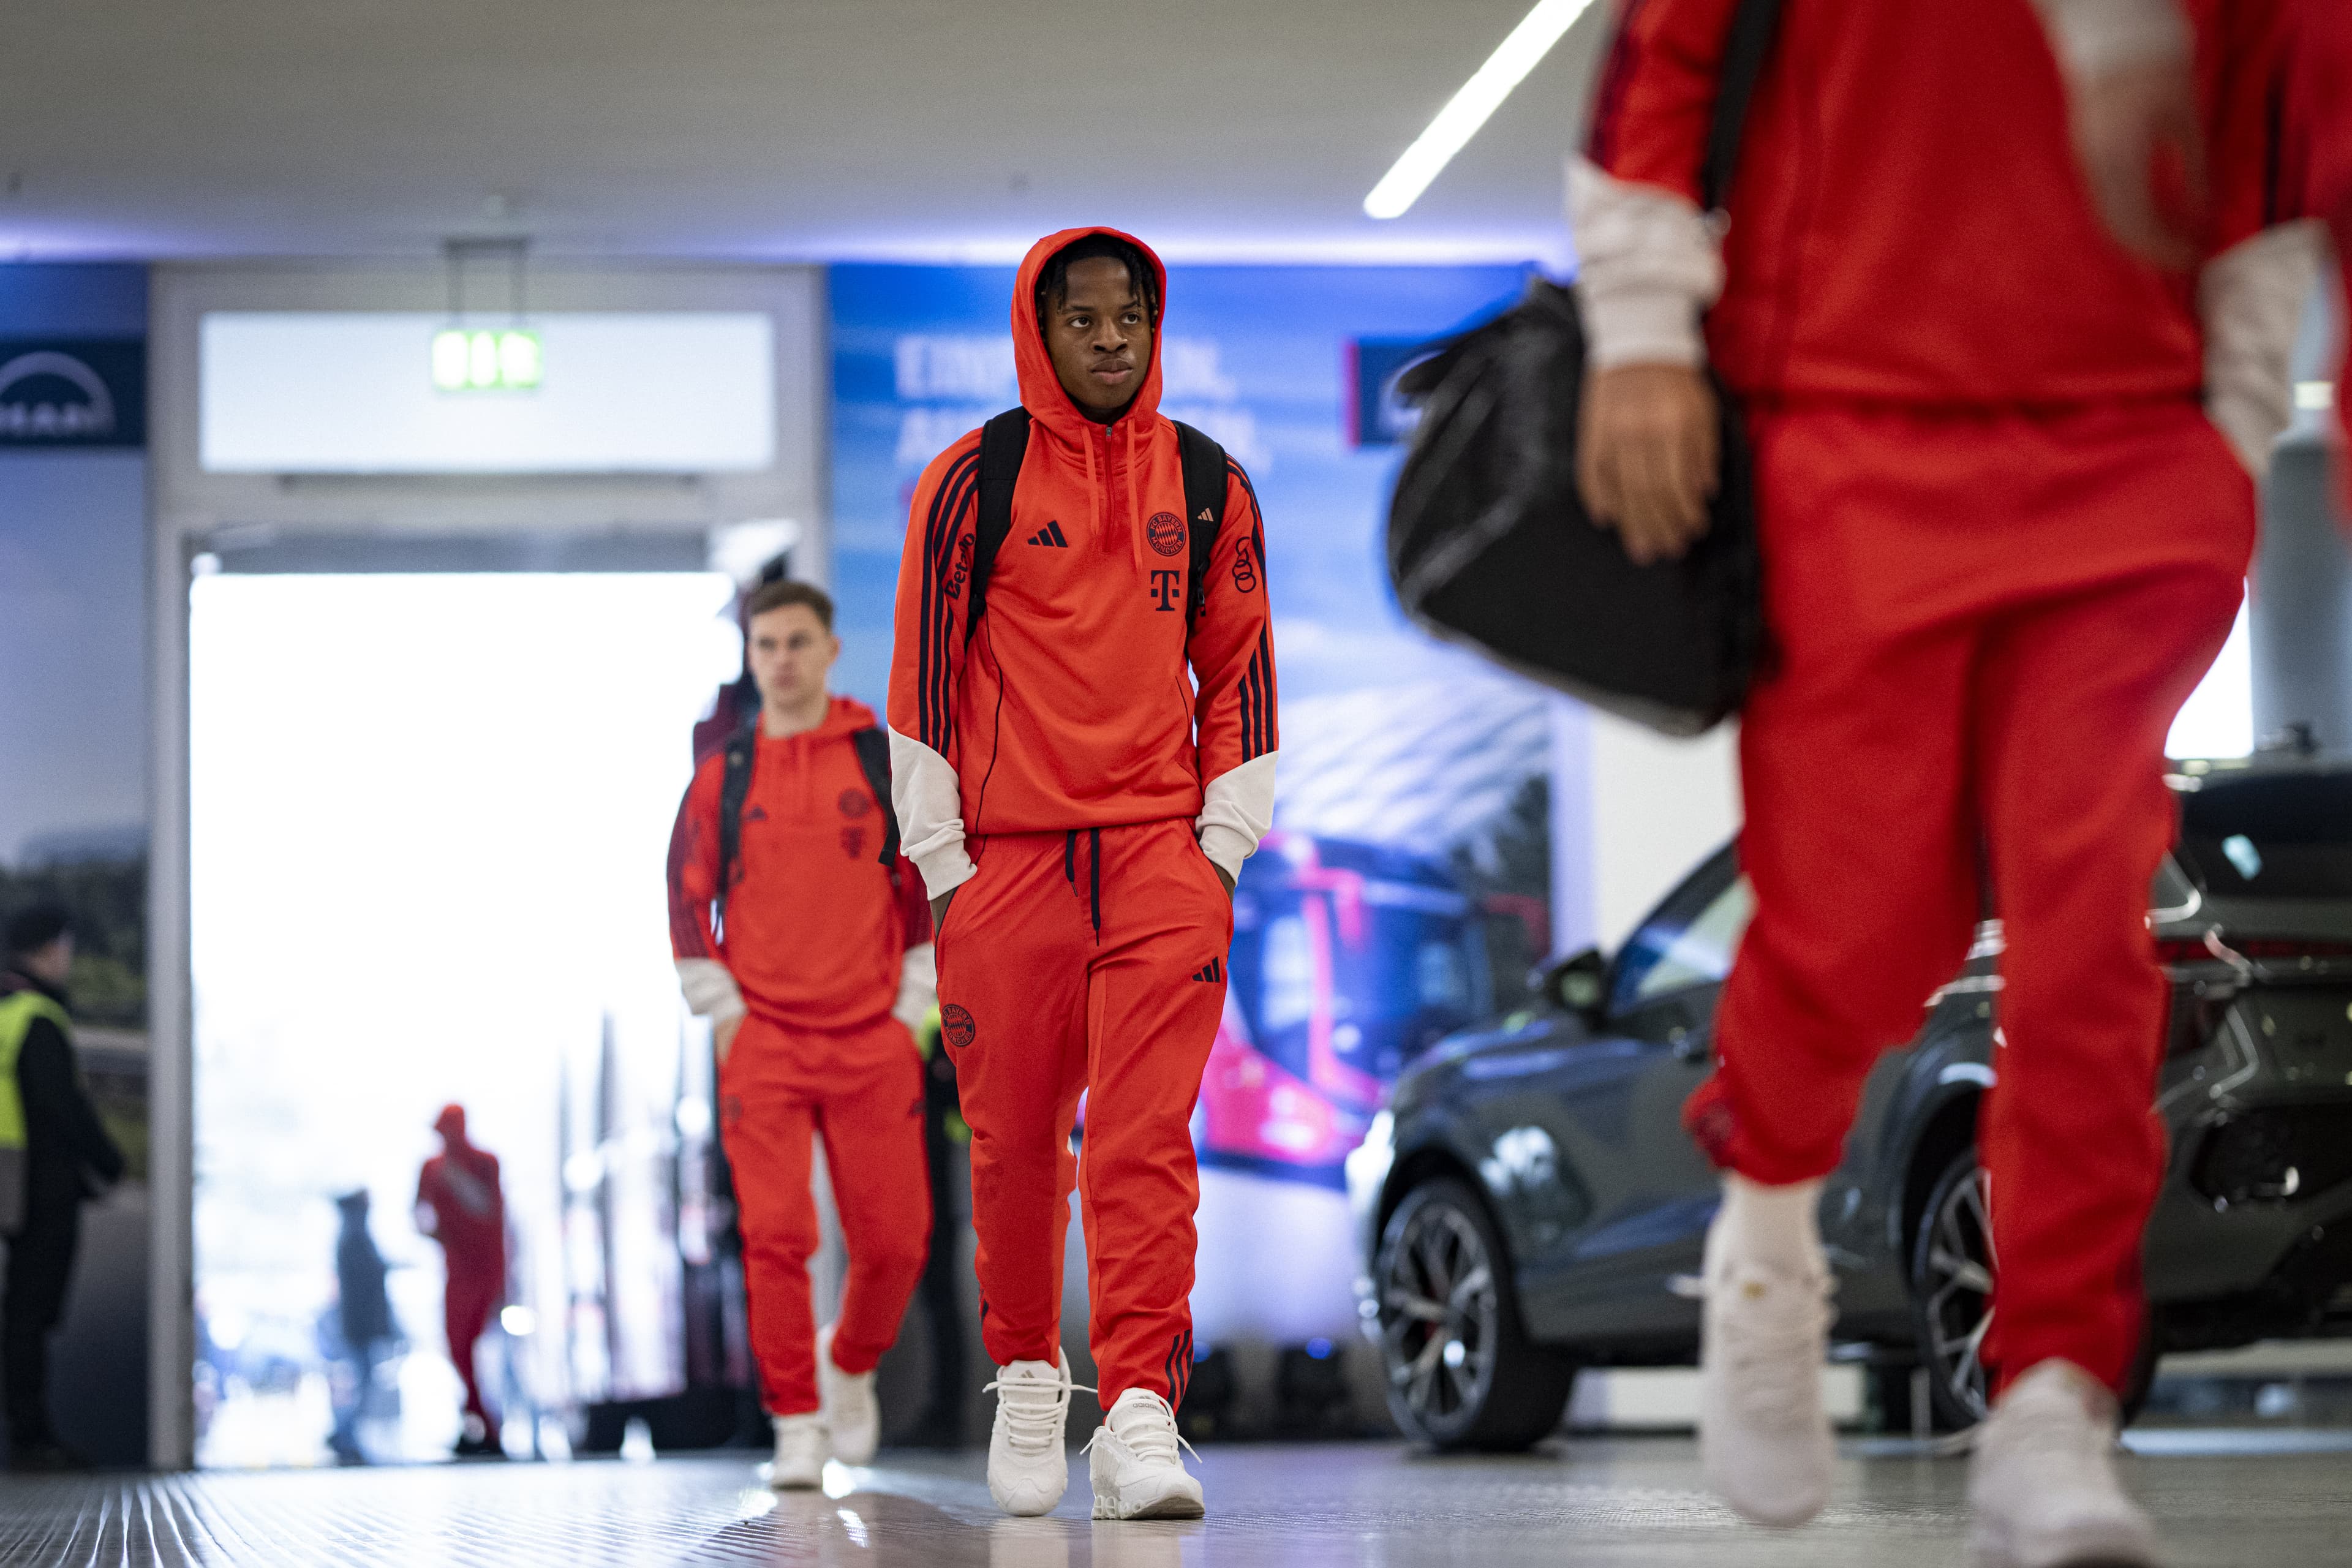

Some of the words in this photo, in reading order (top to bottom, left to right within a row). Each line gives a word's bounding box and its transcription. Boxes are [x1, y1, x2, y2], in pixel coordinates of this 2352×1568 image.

[1150, 519, 1158, 529] FC
[1157, 516, 1183, 532] BAYERN
[1151, 570, 1180, 611] T
